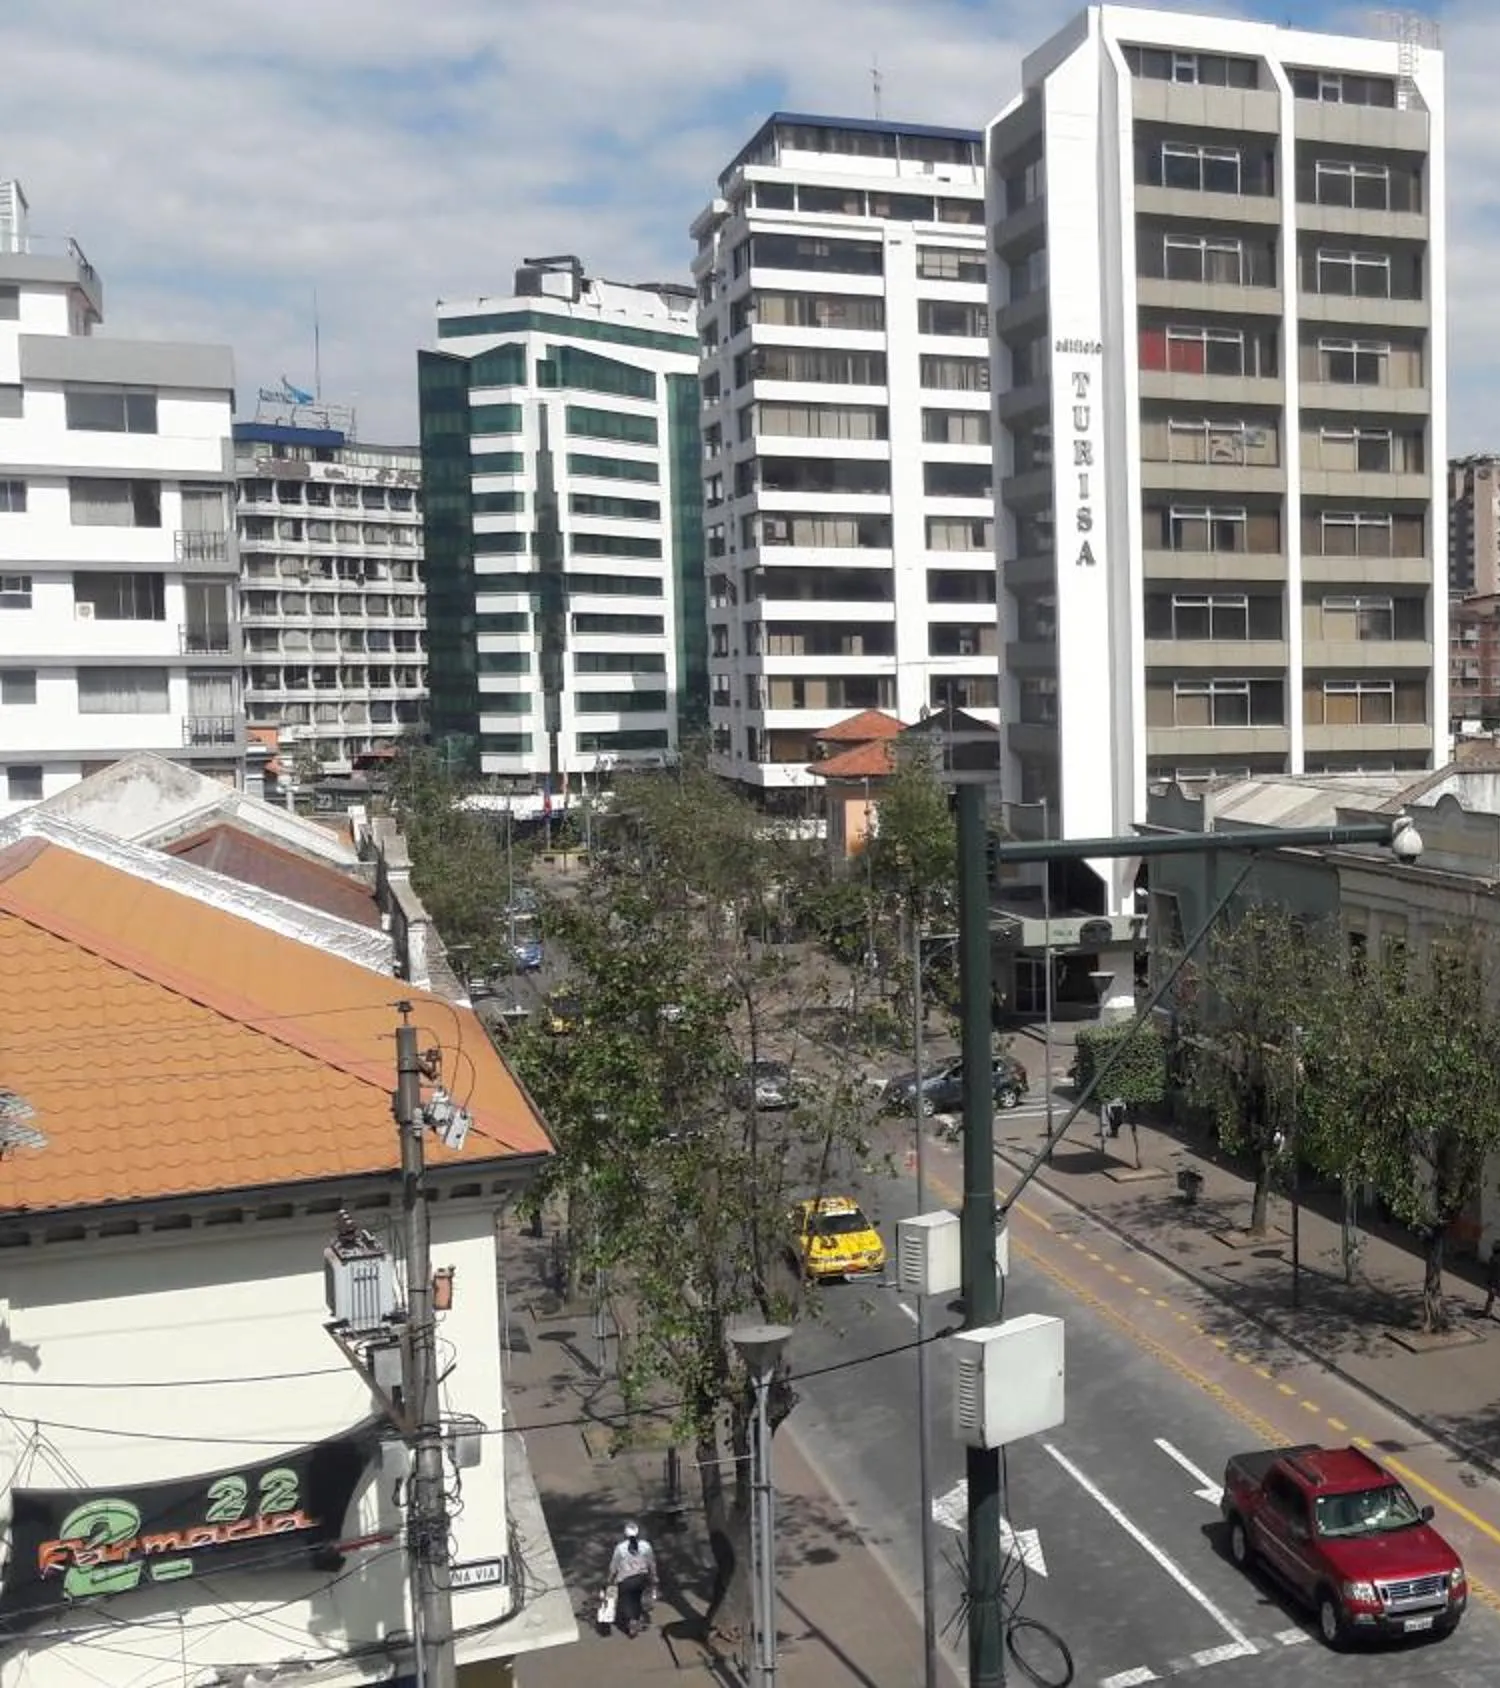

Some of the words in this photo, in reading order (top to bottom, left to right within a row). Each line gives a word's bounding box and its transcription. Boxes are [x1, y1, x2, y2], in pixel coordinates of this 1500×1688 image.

[1071, 372, 1096, 566] TURISA
[450, 1570, 471, 1583] NA
[475, 1567, 496, 1581] VIA
